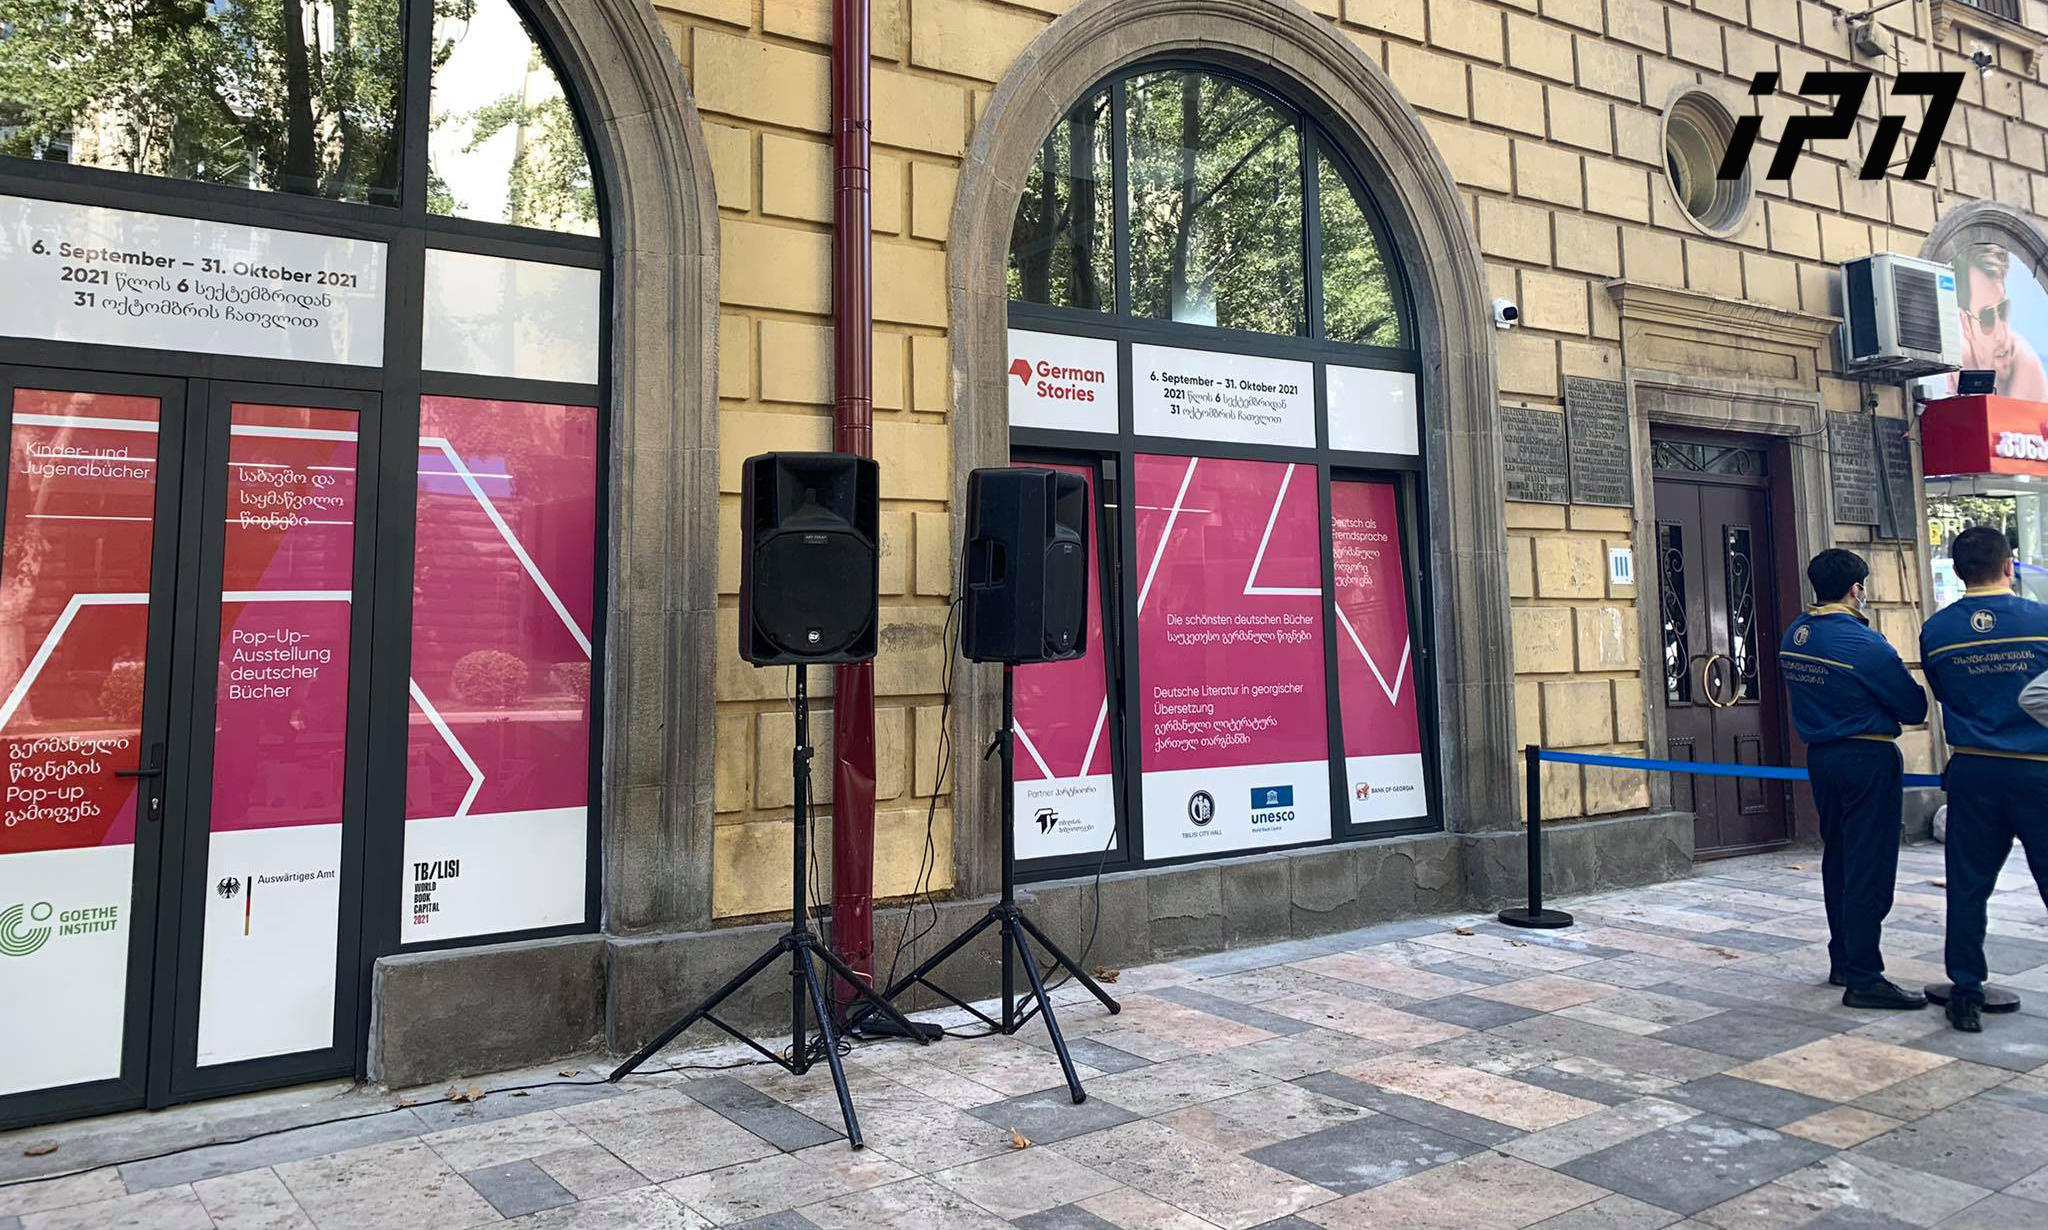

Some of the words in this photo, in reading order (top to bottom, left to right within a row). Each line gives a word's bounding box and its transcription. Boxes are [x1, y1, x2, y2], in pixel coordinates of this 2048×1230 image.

[32, 240, 51, 256] 6.
[59, 242, 176, 269] September
[201, 258, 226, 275] 31.
[233, 262, 312, 283] Oktober
[316, 270, 358, 288] 2021
[60, 266, 109, 285] 2021
[115, 272, 171, 294] წლის
[176, 278, 190, 293] 6
[195, 280, 332, 310] სექტემბრიდან
[74, 291, 95, 307] 31
[102, 296, 220, 320] ოქტომბრის
[225, 306, 319, 330] ჩათვლით
[1036, 360, 1105, 384] German
[1036, 380, 1095, 402] Stories
[1150, 370, 1159, 382] 6.
[1162, 372, 1214, 387] September
[1225, 378, 1238, 390] 31.
[1239, 380, 1276, 394] Oktober
[1278, 384, 1298, 395] 2021
[1164, 388, 1185, 400] 2021
[1187, 390, 1213, 404] წლის
[1215, 393, 1221, 403] 6
[1222, 394, 1287, 411] სექტემბრიდან
[1170, 404, 1180, 414] 31
[1182, 405, 1237, 420] ოქტომბრის
[1238, 412, 1282, 425] ჩათვლით
[26, 442, 89, 458] Kinder-
[95, 446, 129, 459] und
[20, 460, 150, 479] Jugendbücher
[239, 468, 307, 488] საბავშო
[312, 474, 336, 489] და
[240, 490, 344, 510] საყმაწვილო
[240, 510, 310, 531] წიგნები
[1364, 518, 1377, 529] als
[1167, 613, 1182, 626] Die
[1185, 614, 1232, 626] schönsten
[1234, 614, 1282, 626] deutschen
[1284, 613, 1314, 625] Bücher
[232, 628, 310, 646] Pop-Up-
[1167, 630, 1220, 645] საუკეთესო
[1222, 630, 1276, 645] გერმანული
[1276, 629, 1312, 644] წიგნები
[232, 646, 331, 664] Ausstellung
[230, 664, 320, 681] deutscher
[229, 684, 292, 700] Bücher
[1153, 686, 1199, 698] Deutsche
[1202, 684, 1239, 696] Literatur
[1241, 684, 1250, 695] in
[1251, 682, 1304, 696] georgischer
[1154, 701, 1214, 716] Übersetzung
[1154, 719, 1212, 736] გერმანული
[1213, 715, 1278, 732] ლიტერატურა
[10, 736, 130, 760] გერმანული
[1154, 737, 1198, 753] ქართულ
[1200, 732, 1250, 748] თარგმანში
[10, 759, 100, 783] წიგნების
[6, 786, 84, 804] Pop-up
[1027, 789, 1054, 798] Partner
[4, 801, 100, 828] გამოფენა
[1251, 810, 1296, 824] unesco
[1198, 830, 1210, 838] CITY
[257, 872, 315, 885] Auswärtiges
[316, 870, 336, 879] Amt
[414, 859, 460, 881] TB/LISI
[414, 882, 436, 892] WORLD
[414, 893, 431, 903] BOOK
[60, 906, 118, 922] GOETHE
[414, 902, 440, 914] CAPITAL
[60, 920, 118, 936] INSTITUT
[414, 914, 429, 925] 2021
